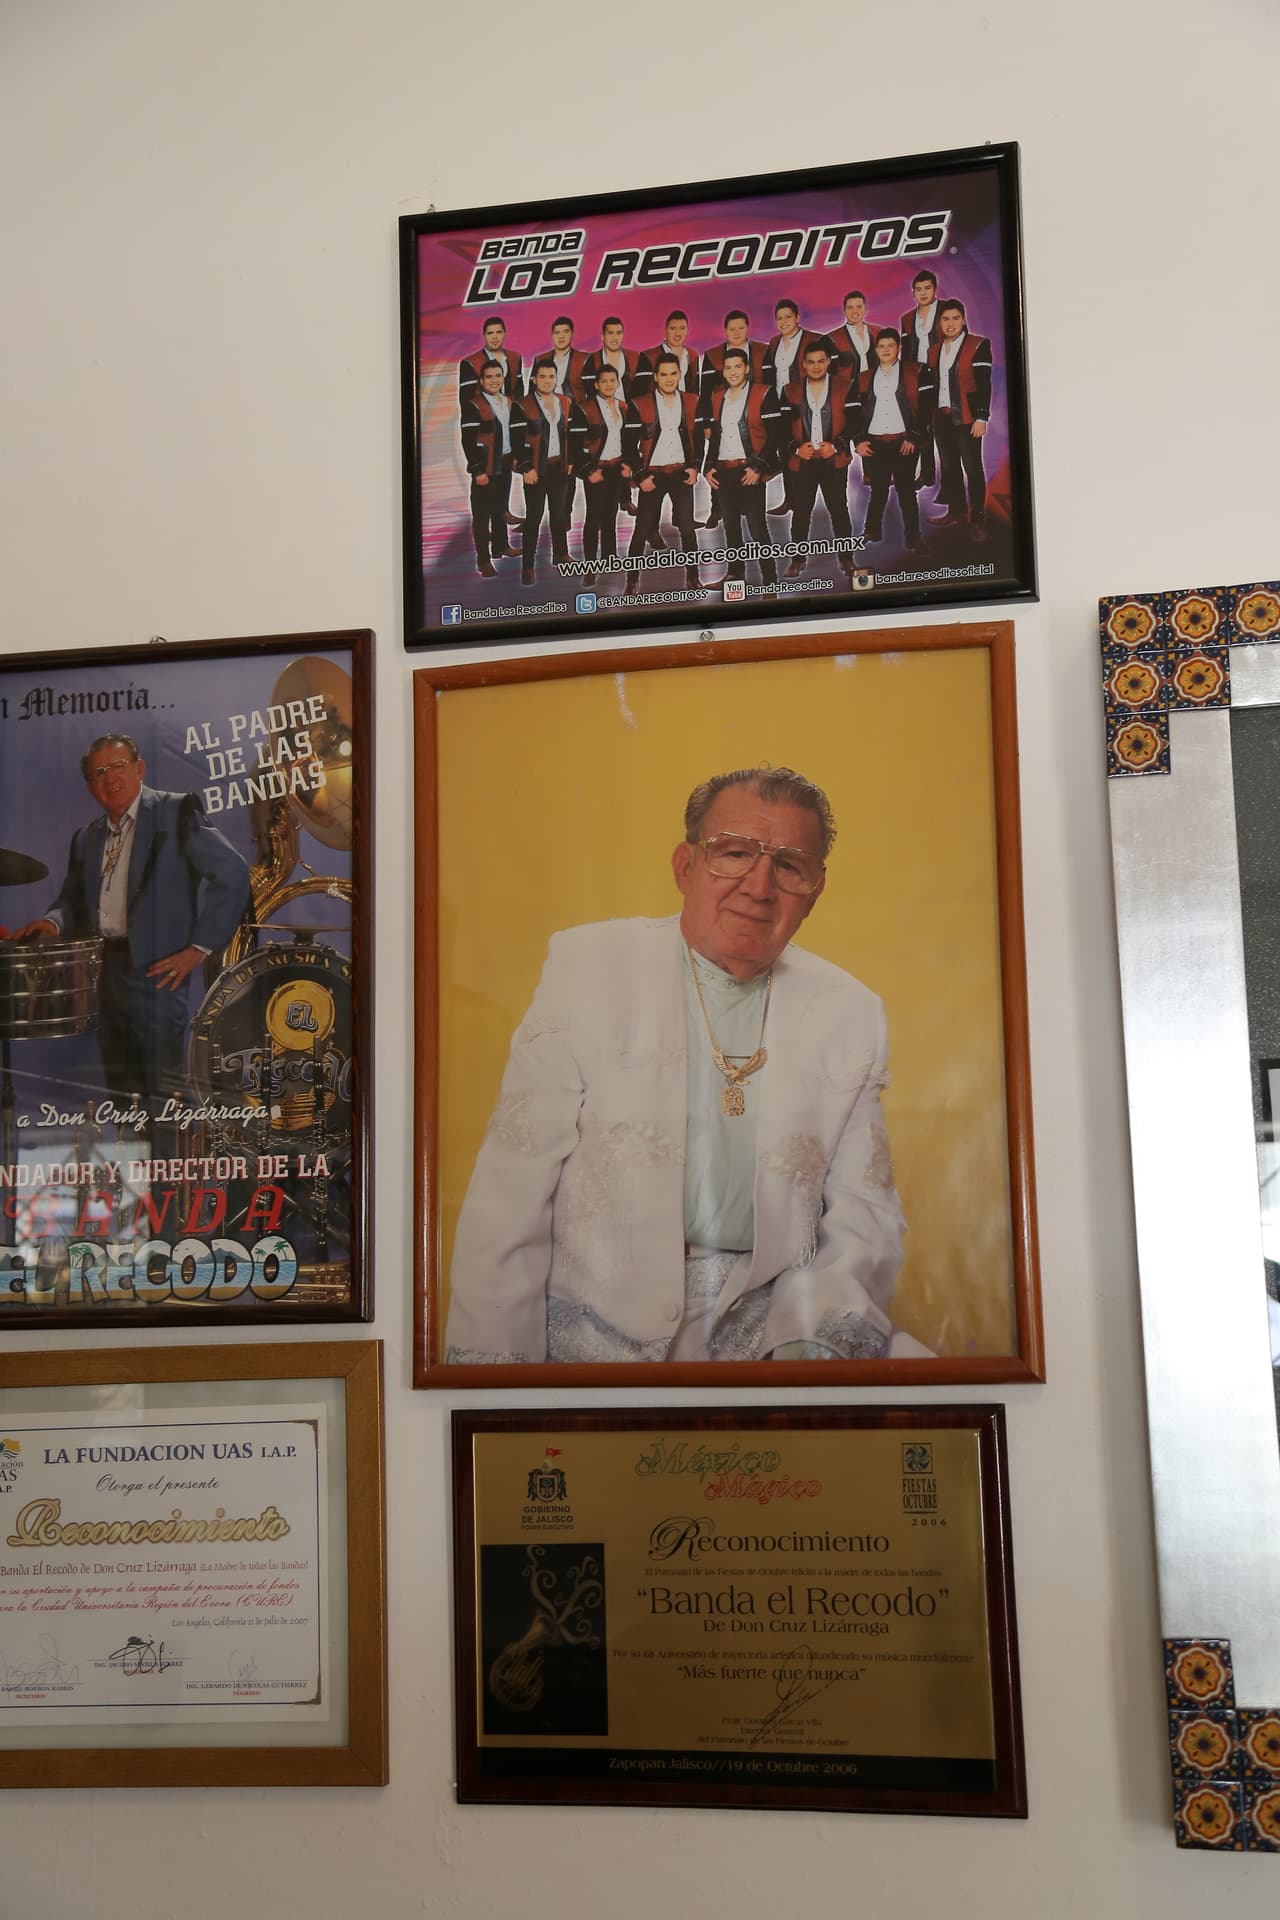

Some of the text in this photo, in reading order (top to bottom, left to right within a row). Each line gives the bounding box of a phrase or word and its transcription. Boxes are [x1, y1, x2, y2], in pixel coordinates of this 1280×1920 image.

[463, 258, 580, 305] LOS
[558, 535, 865, 577] www.bandalosrecoditos.com.mx
[875, 564, 994, 584] bandarecoditosoficial
[727, 583, 742, 592] You
[747, 579, 833, 596] BandaRecoditos
[464, 602, 567, 620] Banda Los Recoditos
[184, 695, 327, 754] AL PADRE
[206, 731, 313, 780] DE LAS
[203, 760, 327, 814] BANDAS
[286, 1001, 319, 1033] EL
[17, 1115, 30, 1128] a
[37, 1104, 86, 1127] Don
[154, 1096, 269, 1132] Lizárraga
[106, 1160, 122, 1184] Y
[127, 1156, 249, 1183] DIRECTOR
[257, 1153, 290, 1180] DE
[297, 1152, 331, 1178] LA
[4, 1185, 285, 1239] BANDA
[68, 1236, 298, 1304] RECODO
[43, 1442, 297, 1465] LA FUNDACION UAS I.A.P.
[96, 1473, 221, 1496] Otorga el presente
[902, 1477, 937, 1493] FIESTAS
[523, 1505, 571, 1513] GOBIERNO
[902, 1494, 938, 1509] OCTUBRE
[6, 1498, 291, 1547] Reconocimiento
[522, 1515, 573, 1523] DE JALISCO
[911, 1517, 947, 1527] 2006
[648, 1515, 890, 1561] Reconocimiento
[0, 1561, 30, 1576] Banda
[32, 1560, 42, 1575] El
[46, 1561, 78, 1575] Recodo
[80, 1560, 91, 1574] de
[94, 1563, 114, 1574] Don
[117, 1562, 144, 1573] Cruz
[767, 1584, 795, 1616] el
[290, 1618, 308, 1627] 2007
[703, 1618, 890, 1636] De Don Cruz Lizárraga
[721, 1664, 767, 1680] fuerte
[772, 1667, 803, 1683] que
[609, 1757, 666, 1773] Zapopan
[747, 1759, 763, 1772] de
[767, 1760, 819, 1775] Octubre
[823, 1762, 857, 1775] 2006
